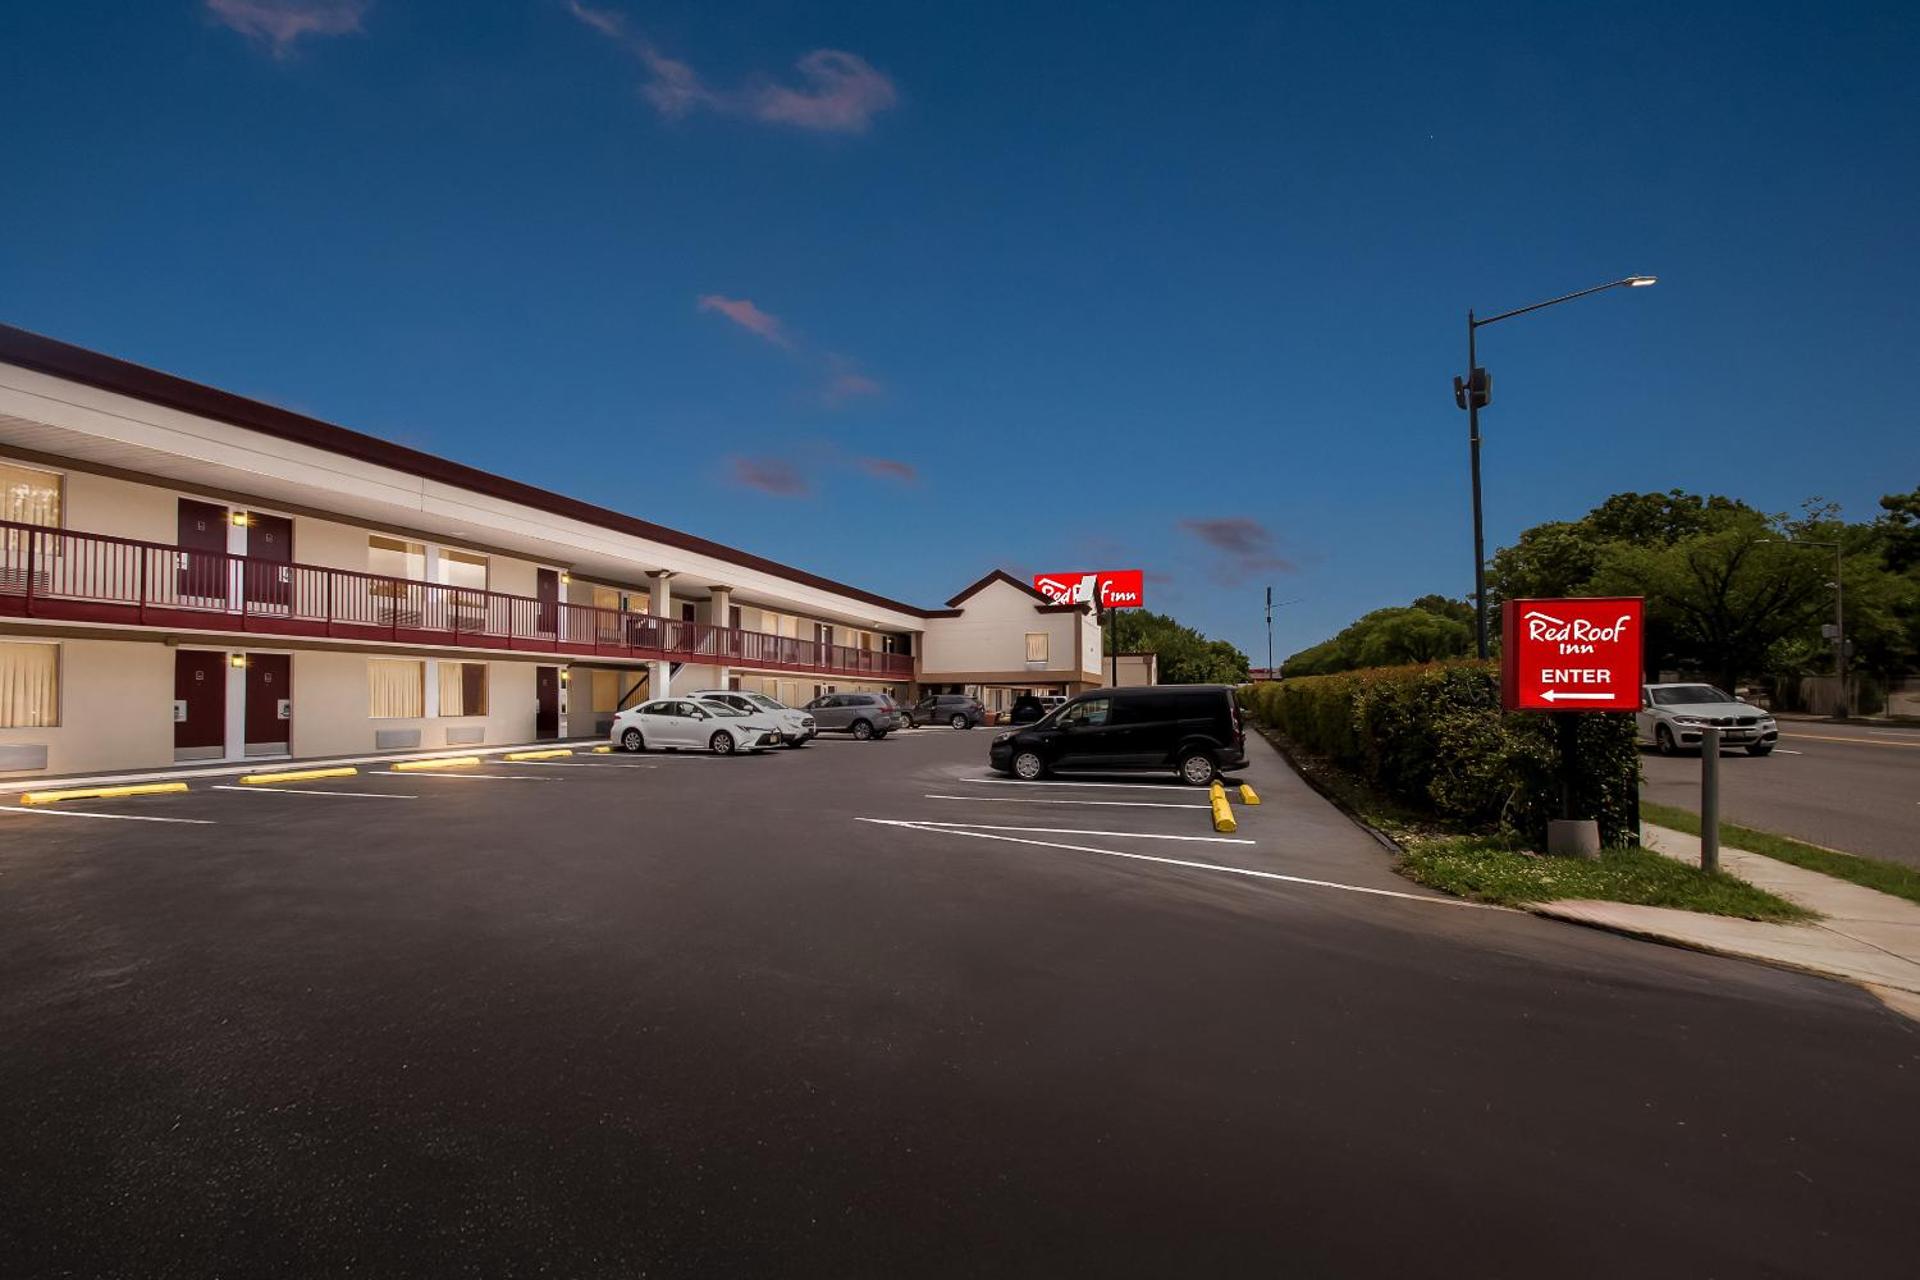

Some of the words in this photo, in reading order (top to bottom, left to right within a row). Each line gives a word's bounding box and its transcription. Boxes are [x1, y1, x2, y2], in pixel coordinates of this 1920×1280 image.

[1529, 619, 1571, 642] Red
[1573, 615, 1631, 643] Roof
[1559, 643, 1594, 655] Inn
[1541, 669, 1611, 683] ENTER
